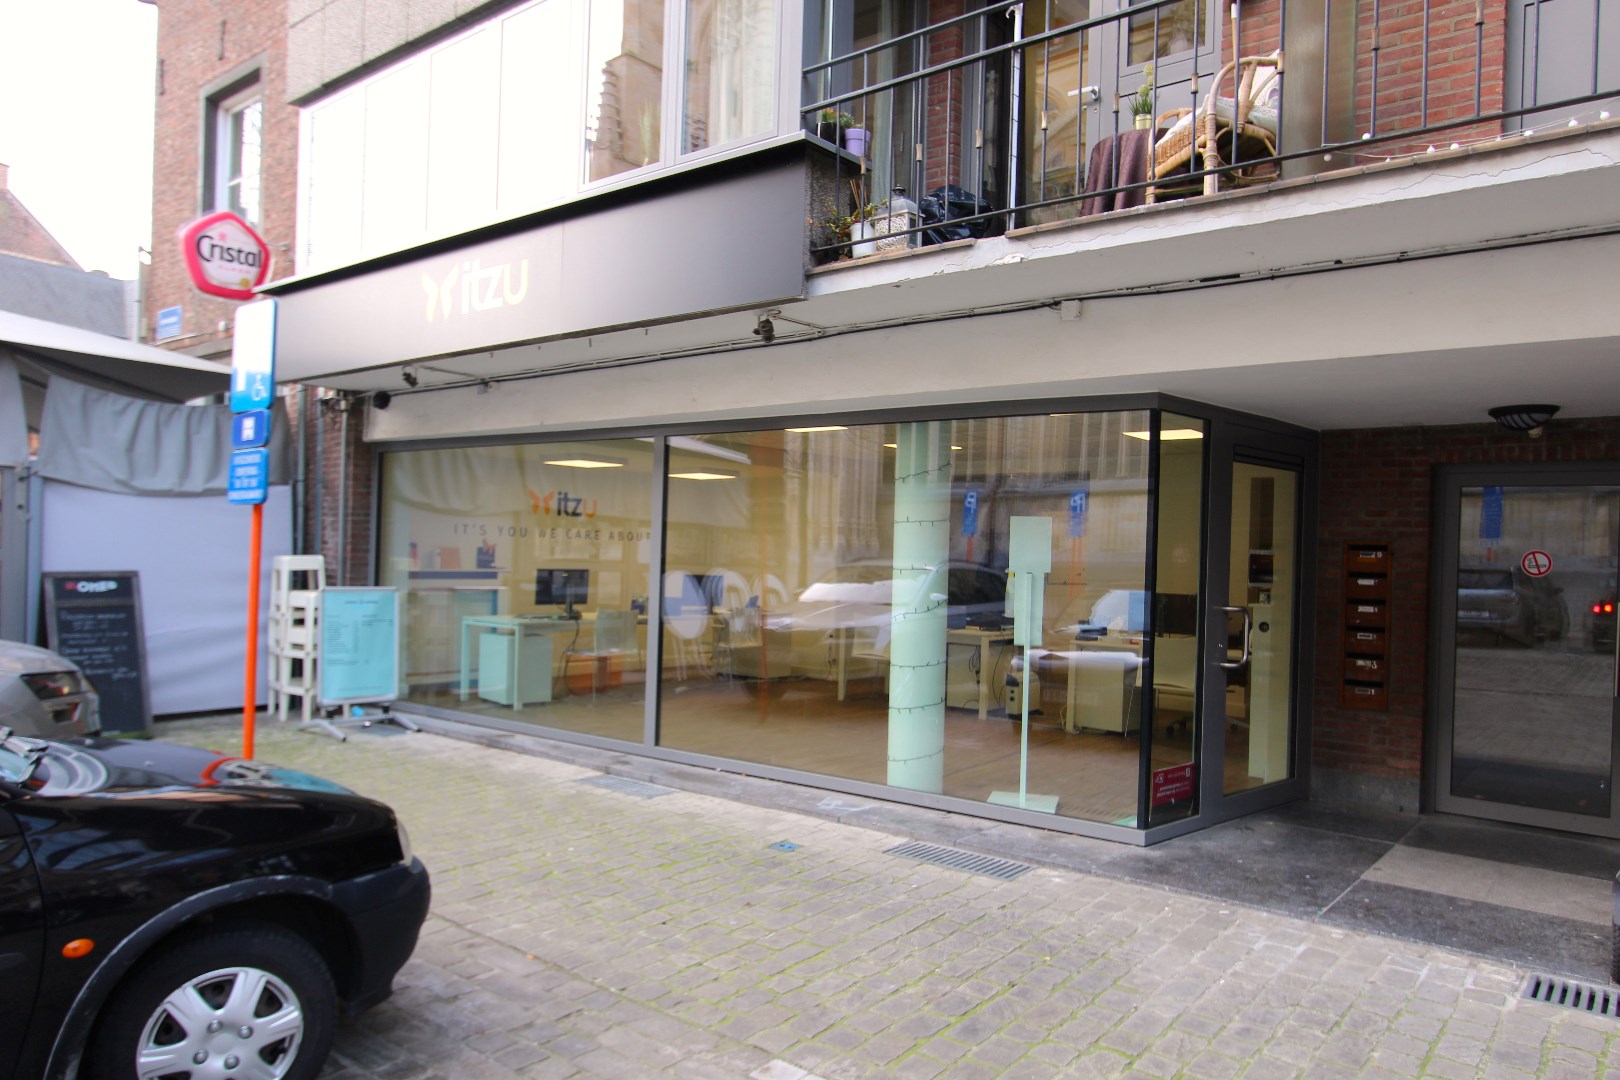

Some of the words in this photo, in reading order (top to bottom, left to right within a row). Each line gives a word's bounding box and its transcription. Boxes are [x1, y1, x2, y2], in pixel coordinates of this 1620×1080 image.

[196, 234, 263, 268] Cristal
[461, 258, 529, 315] itzu
[556, 491, 599, 519] itzu
[453, 523, 487, 536] IT'S
[497, 525, 528, 538] YOU
[538, 527, 557, 539] WE
[565, 528, 601, 541] CARE
